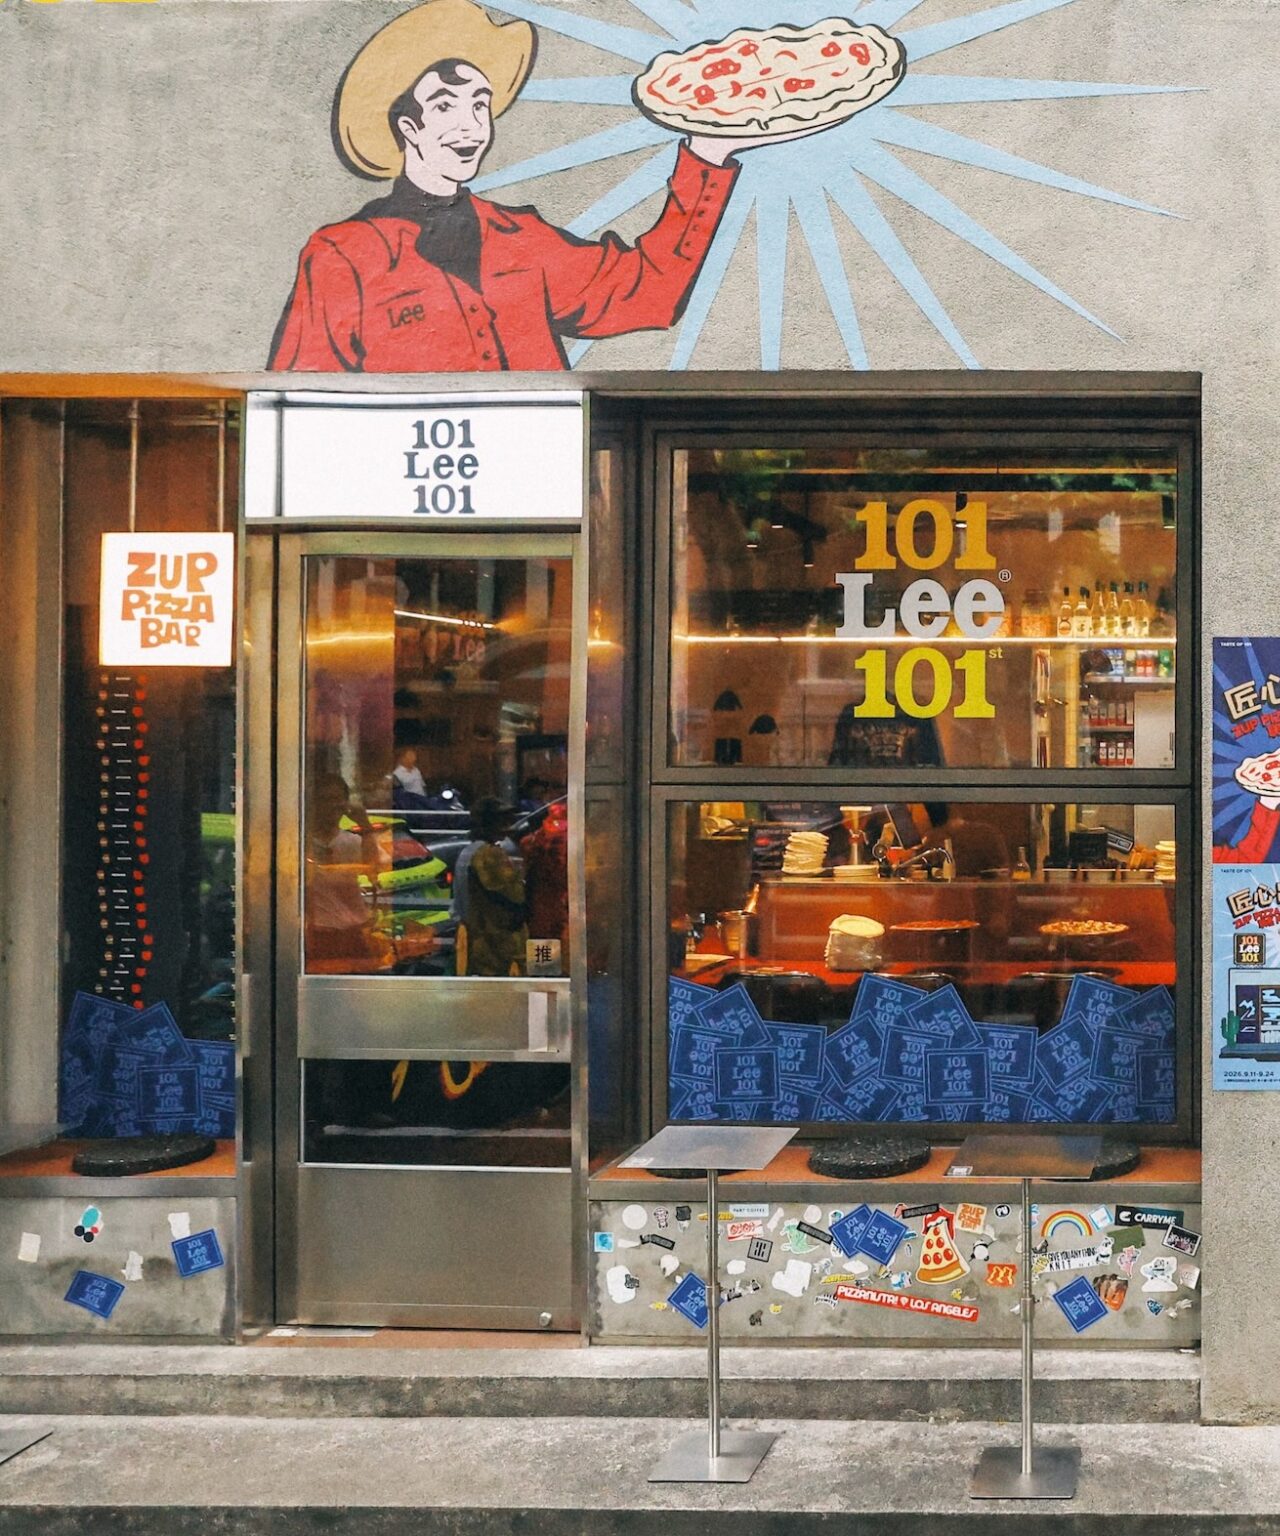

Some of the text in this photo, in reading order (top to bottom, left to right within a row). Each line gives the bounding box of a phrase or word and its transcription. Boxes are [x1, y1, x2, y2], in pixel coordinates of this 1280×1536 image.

[387, 303, 426, 329] Lee
[411, 418, 476, 449] 101
[403, 451, 480, 480] Lee
[412, 483, 476, 515] 101
[854, 499, 997, 571] 101
[127, 552, 218, 593] ZUP
[834, 572, 1006, 639] Lee
[140, 618, 200, 648] BAR
[1241, 935, 1259, 945] 101
[535, 945, 553, 963] 推
[1239, 944, 1260, 953] Lee
[1241, 952, 1259, 962] 101
[882, 988, 902, 1002] 101
[1094, 989, 1114, 1003] 101
[873, 998, 902, 1014] Lee
[1085, 999, 1114, 1015] Lee
[838, 1032, 859, 1049] 101
[842, 1038, 869, 1063] Lee
[736, 1056, 757, 1066] 101
[947, 1057, 968, 1067] 101
[731, 1067, 761, 1079] Lee
[942, 1068, 972, 1080] Lee
[737, 1079, 757, 1090] 101
[948, 1080, 968, 1091] 101
[1134, 1214, 1177, 1225] CARRYME
[867, 1226, 879, 1240] 101
[873, 1228, 887, 1247] Lee
[1073, 1294, 1089, 1313] Lee
[1083, 1292, 1095, 1306] 101
[909, 1299, 930, 1311] LOS
[931, 1303, 977, 1319] ANGELES
